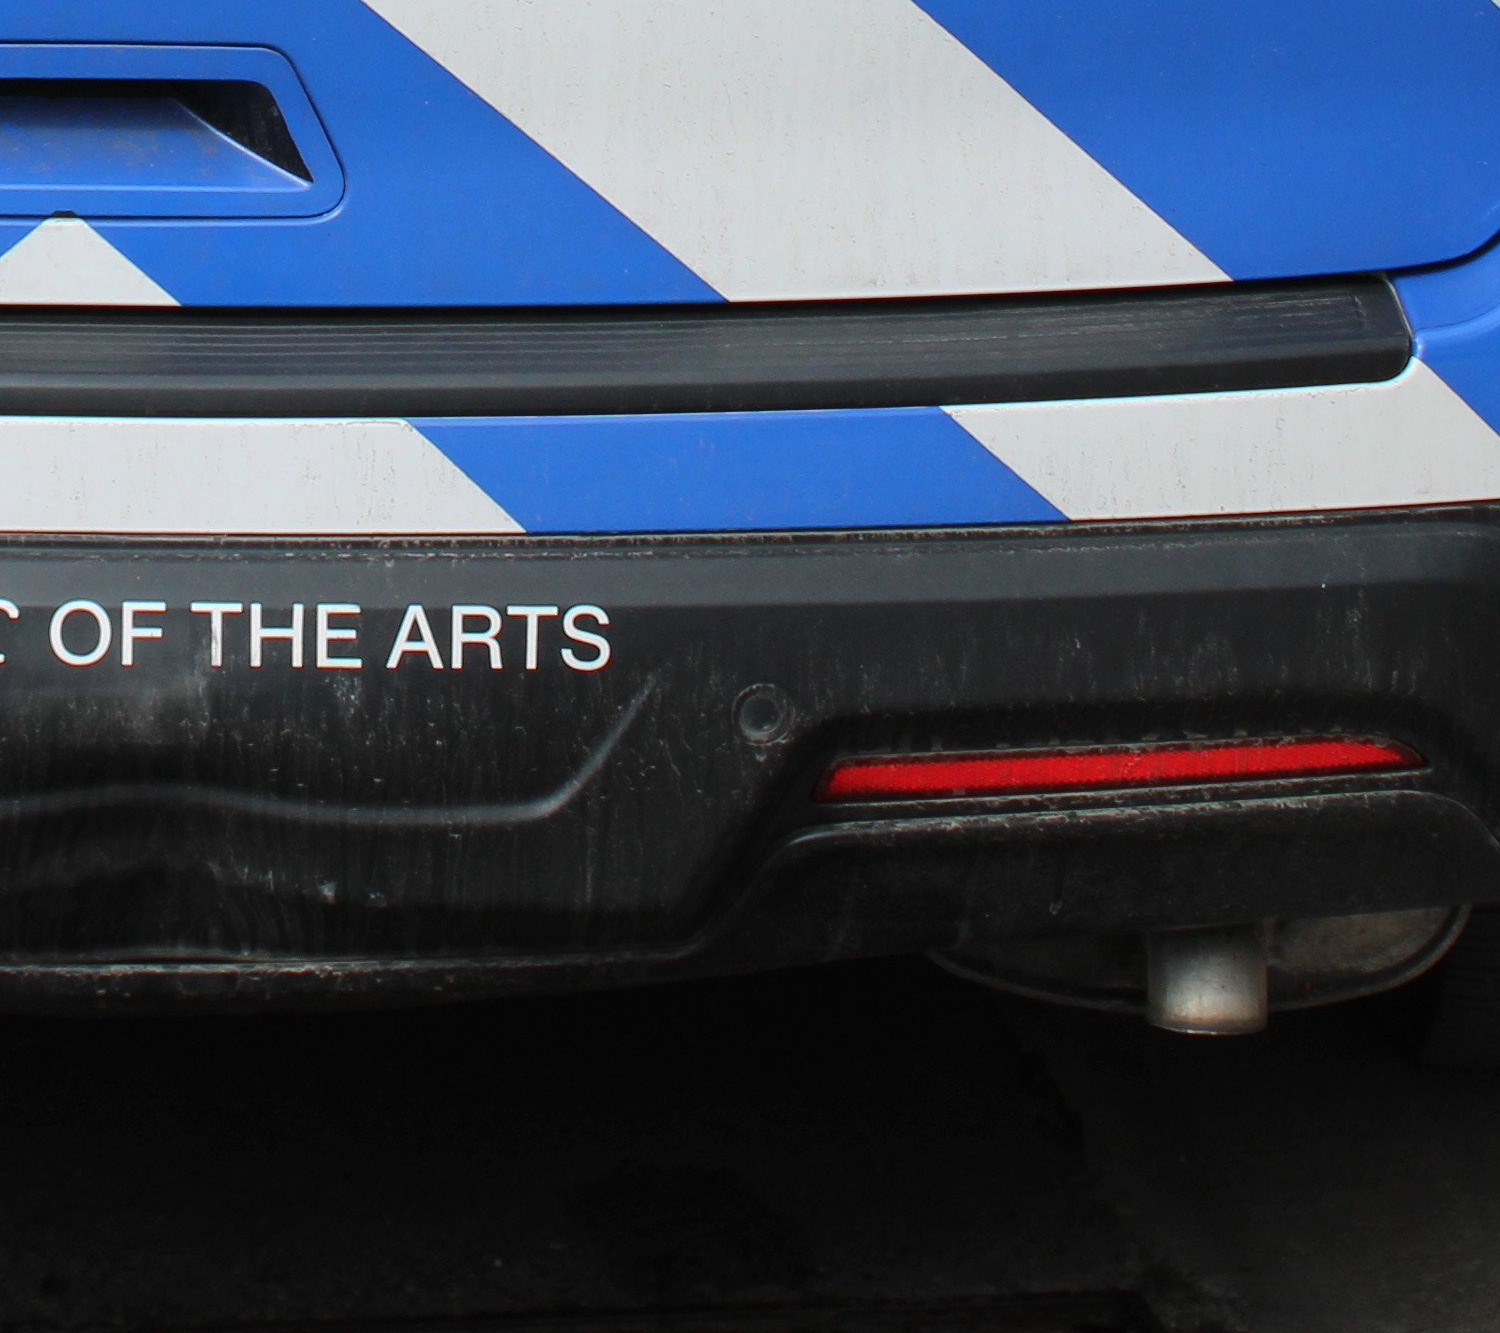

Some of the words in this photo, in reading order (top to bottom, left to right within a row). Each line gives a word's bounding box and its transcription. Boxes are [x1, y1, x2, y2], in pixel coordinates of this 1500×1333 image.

[48, 598, 168, 667] OF
[190, 600, 363, 669] THE
[385, 604, 612, 672] ARTS
